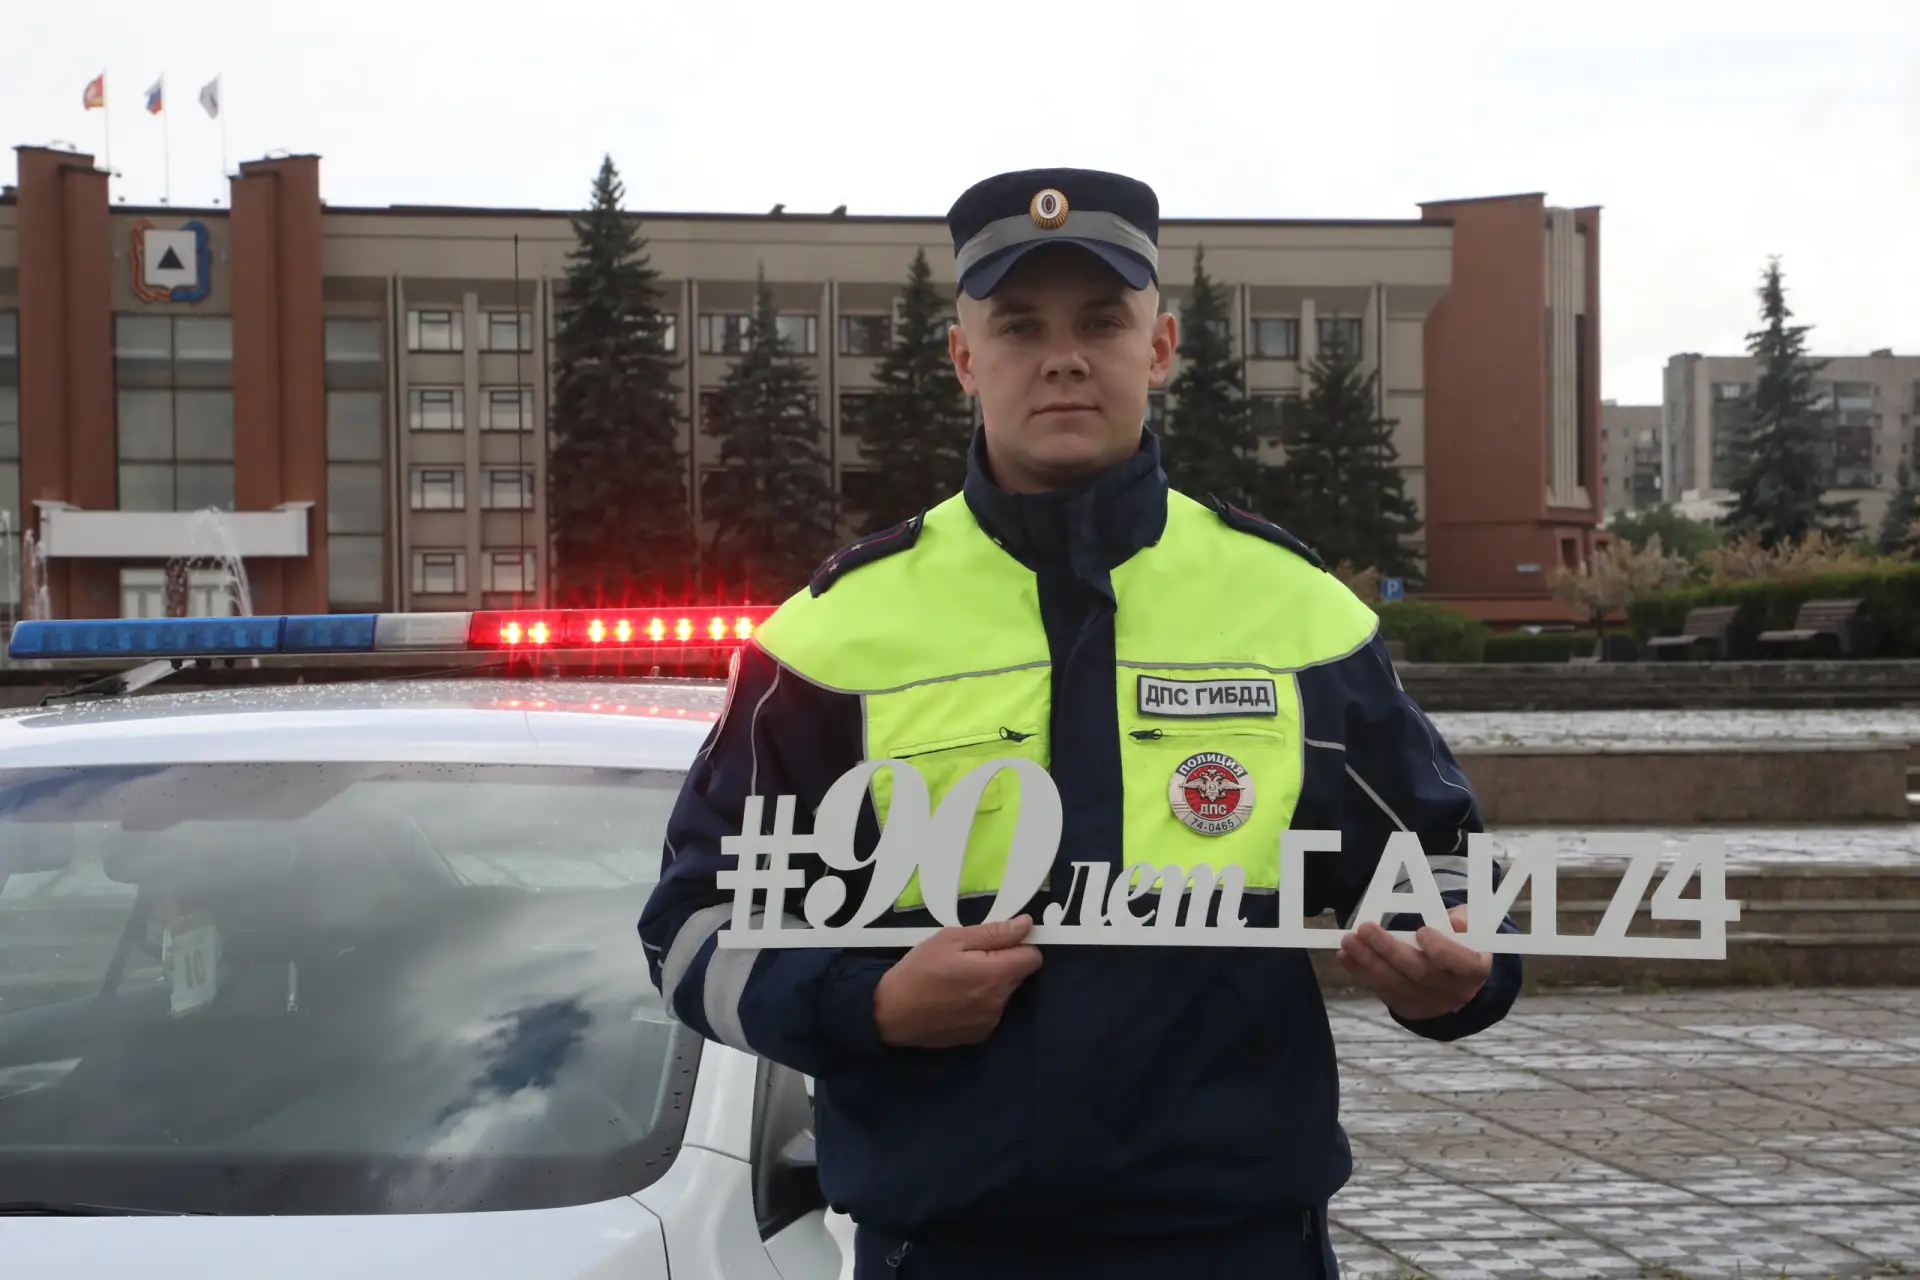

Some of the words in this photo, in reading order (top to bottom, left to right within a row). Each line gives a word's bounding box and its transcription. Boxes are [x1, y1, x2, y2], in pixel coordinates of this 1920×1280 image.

[1387, 581, 1398, 597] P
[1145, 685, 1188, 707] ДПС
[1196, 686, 1271, 707] ГИБДД
[1177, 753, 1245, 778] ПОЛИЦИЯ
[1199, 803, 1227, 816] ДПС
[1190, 818, 1235, 833] 74-0465
